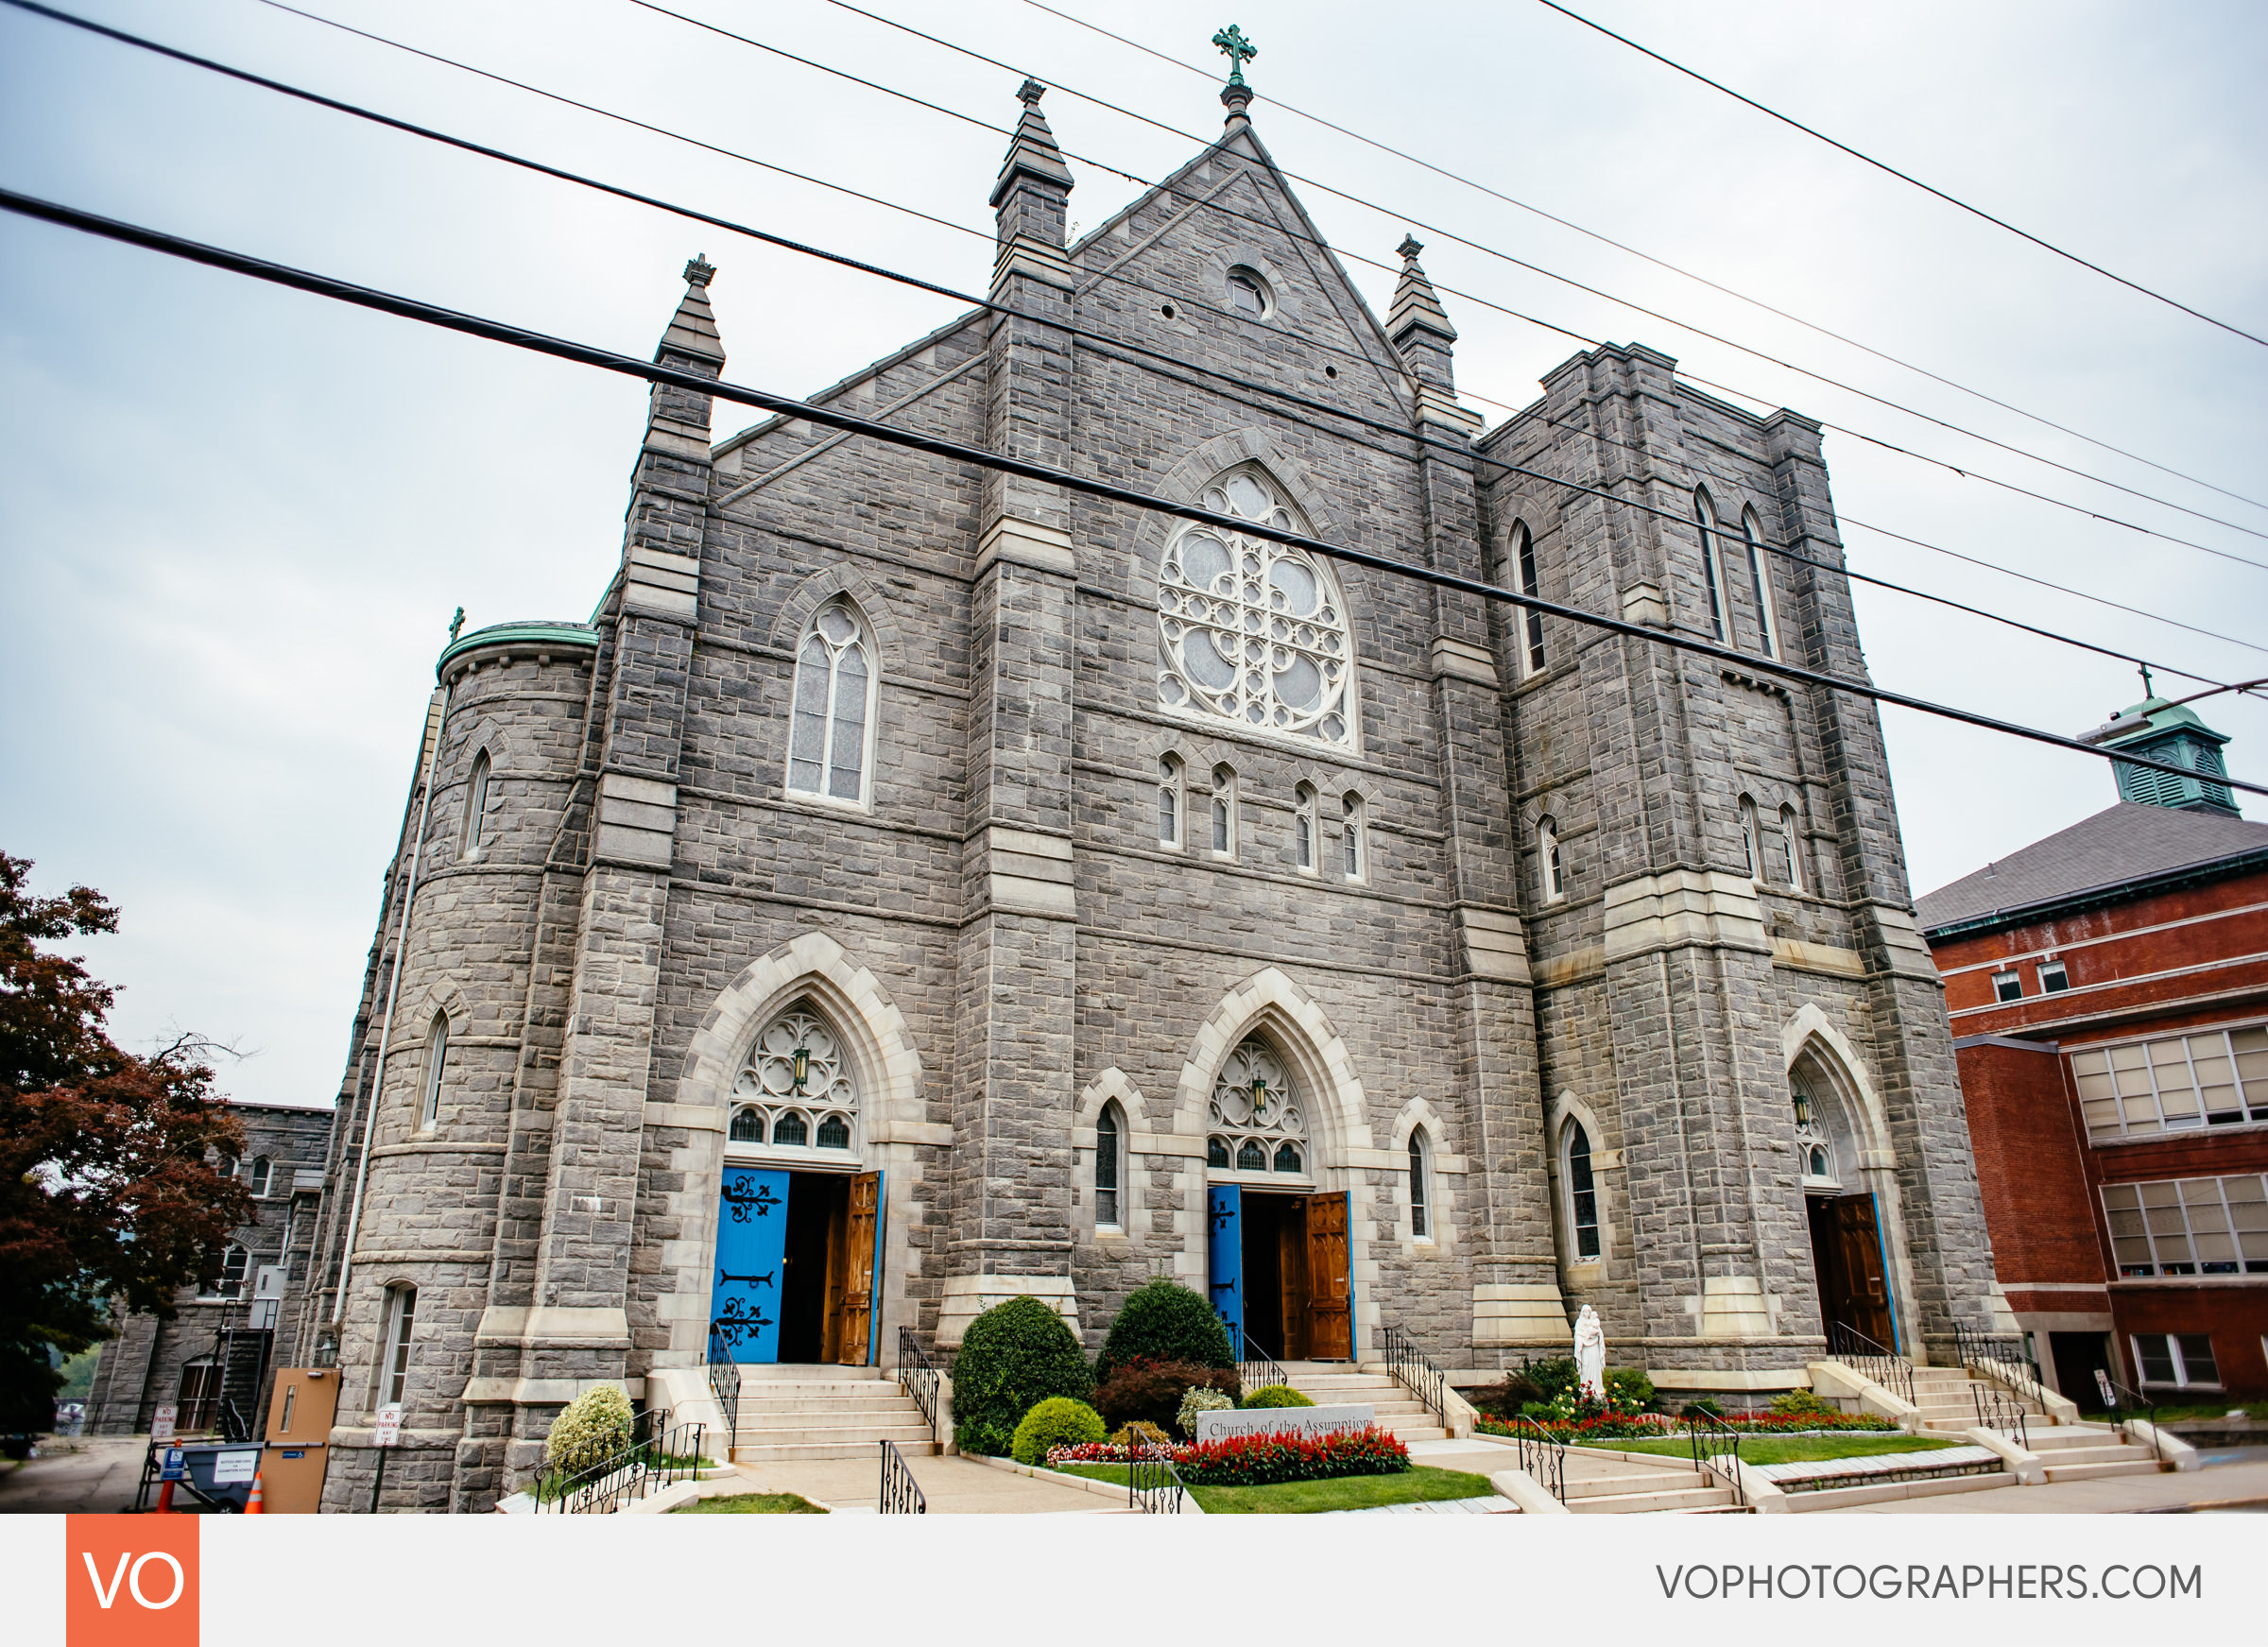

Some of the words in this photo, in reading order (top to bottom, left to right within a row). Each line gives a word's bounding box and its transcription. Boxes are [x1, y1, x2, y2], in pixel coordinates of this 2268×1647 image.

[1210, 1421, 1254, 1436] Church
[1261, 1420, 1274, 1433] of
[1280, 1420, 1297, 1433] the
